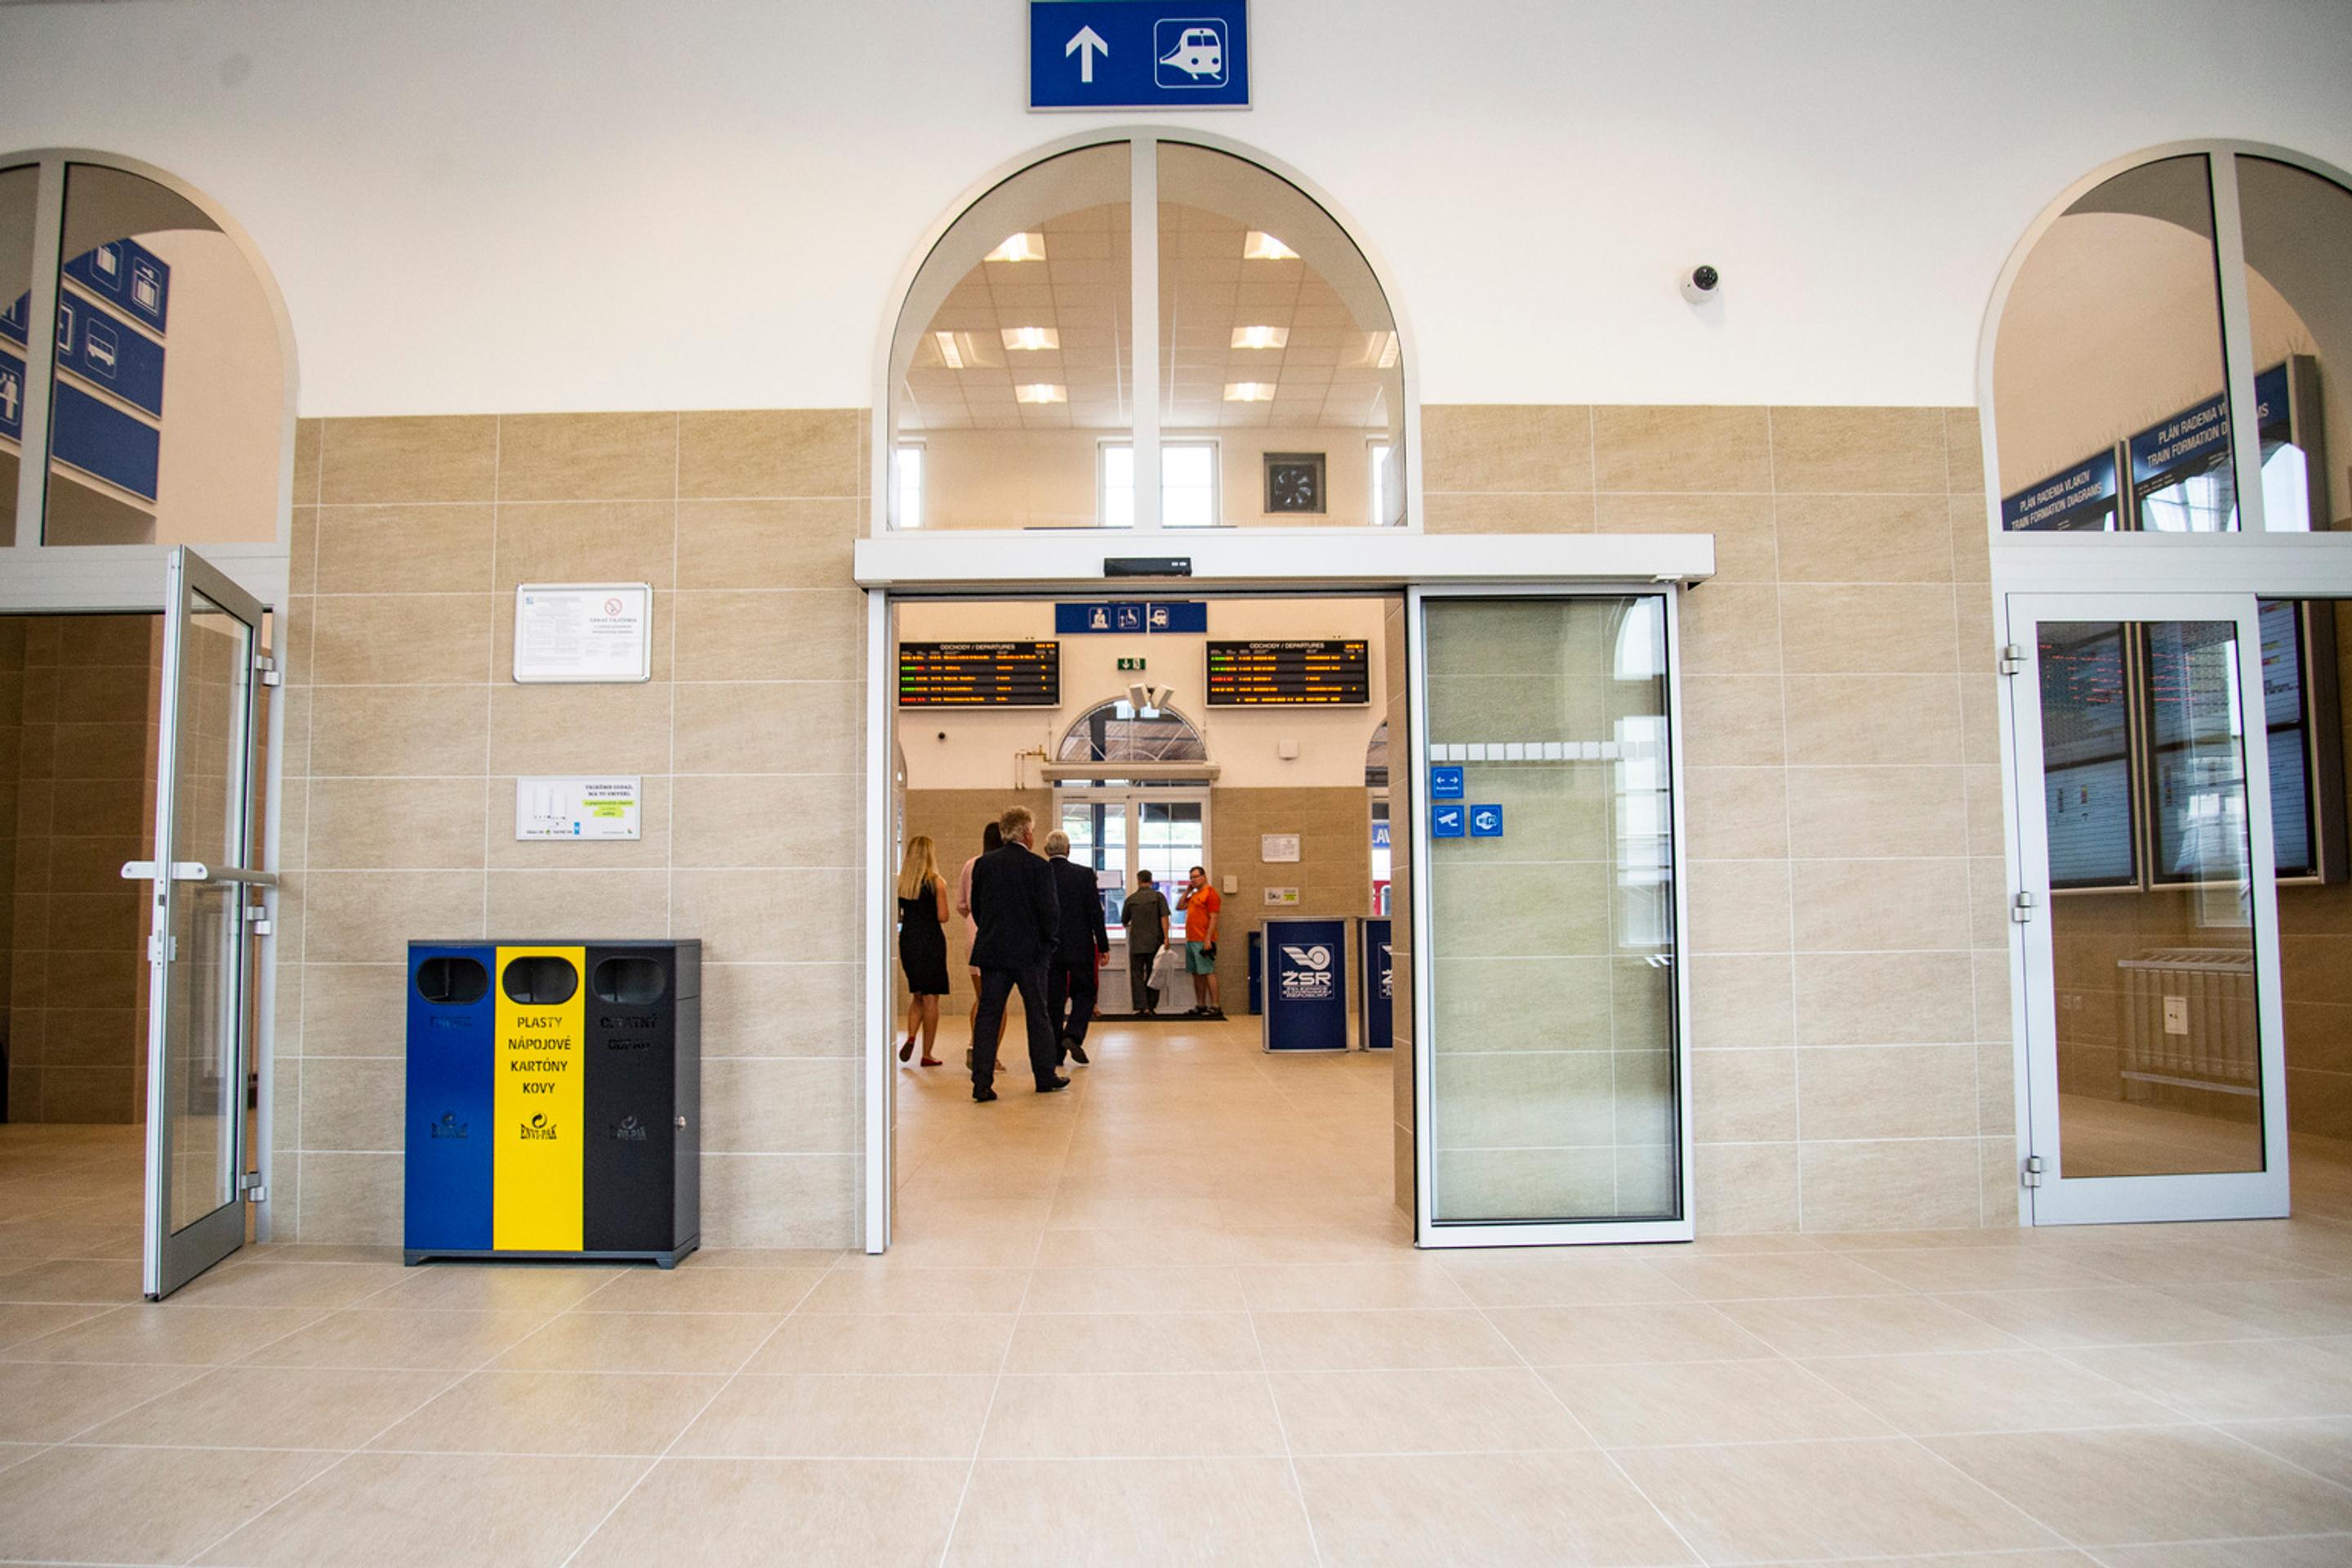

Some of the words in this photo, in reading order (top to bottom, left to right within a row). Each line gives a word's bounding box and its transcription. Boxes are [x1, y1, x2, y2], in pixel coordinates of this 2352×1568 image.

[2158, 423, 2180, 444] PLÁN
[2180, 406, 2217, 435] RADENIA
[2146, 445, 2172, 469] TRAIN
[2172, 425, 2220, 457] FORMATION
[2030, 497, 2067, 524] FORMATION
[2067, 480, 2103, 508] DIAGRAMS
[517, 1017, 563, 1028] PLASTY
[508, 1035, 572, 1050] NÁPOJOVÉ
[510, 1057, 568, 1072] KARTÓNY
[523, 1082, 556, 1094] KOVY
